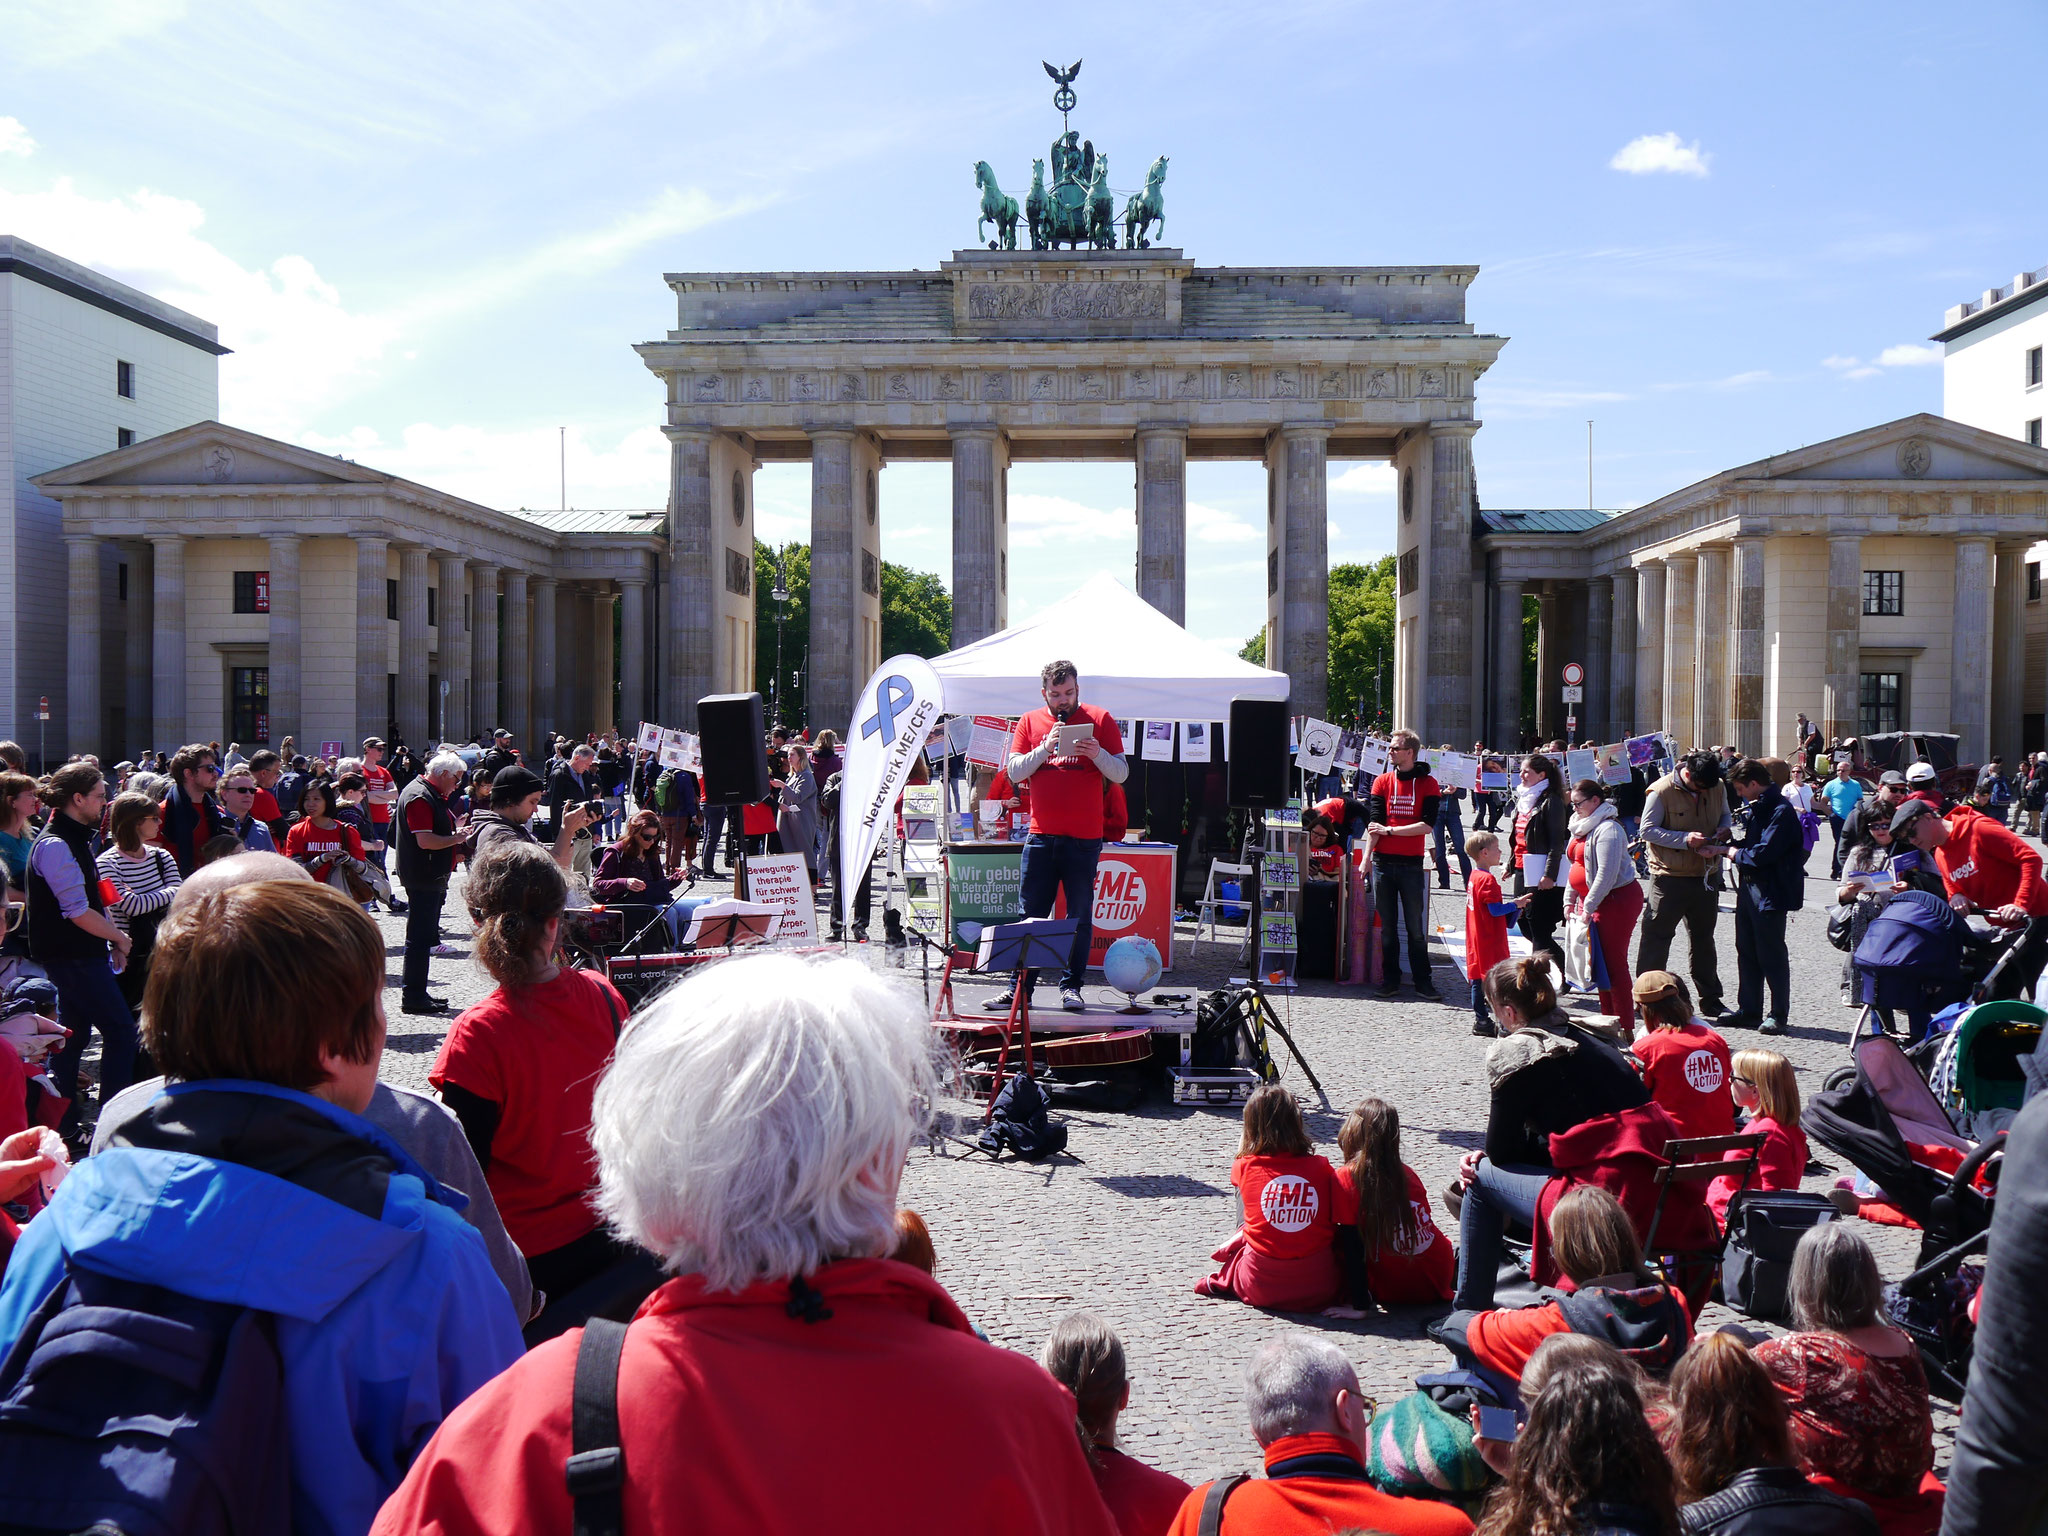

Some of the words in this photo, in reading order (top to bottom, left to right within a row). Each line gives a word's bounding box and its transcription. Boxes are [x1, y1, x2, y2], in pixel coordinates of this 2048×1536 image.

[862, 756, 903, 828] Netzwerk
[895, 699, 934, 757] ME/CFS
[307, 841, 342, 852] MILLION
[747, 864, 800, 875] Bewegungs-
[986, 865, 1020, 884] gebe
[756, 875, 792, 885] therapie
[755, 887, 768, 896] für
[769, 886, 800, 895] schwer
[962, 882, 1020, 893] Betroffenen
[958, 892, 1005, 905] wieder
[982, 902, 1004, 914] eine
[1094, 902, 1143, 920] CTION
[780, 920, 807, 929] örper-
[614, 972, 633, 980] nord
[1687, 1055, 1720, 1078] #ME
[1264, 1182, 1315, 1209] #ME
[1269, 1207, 1317, 1225] ACTION
